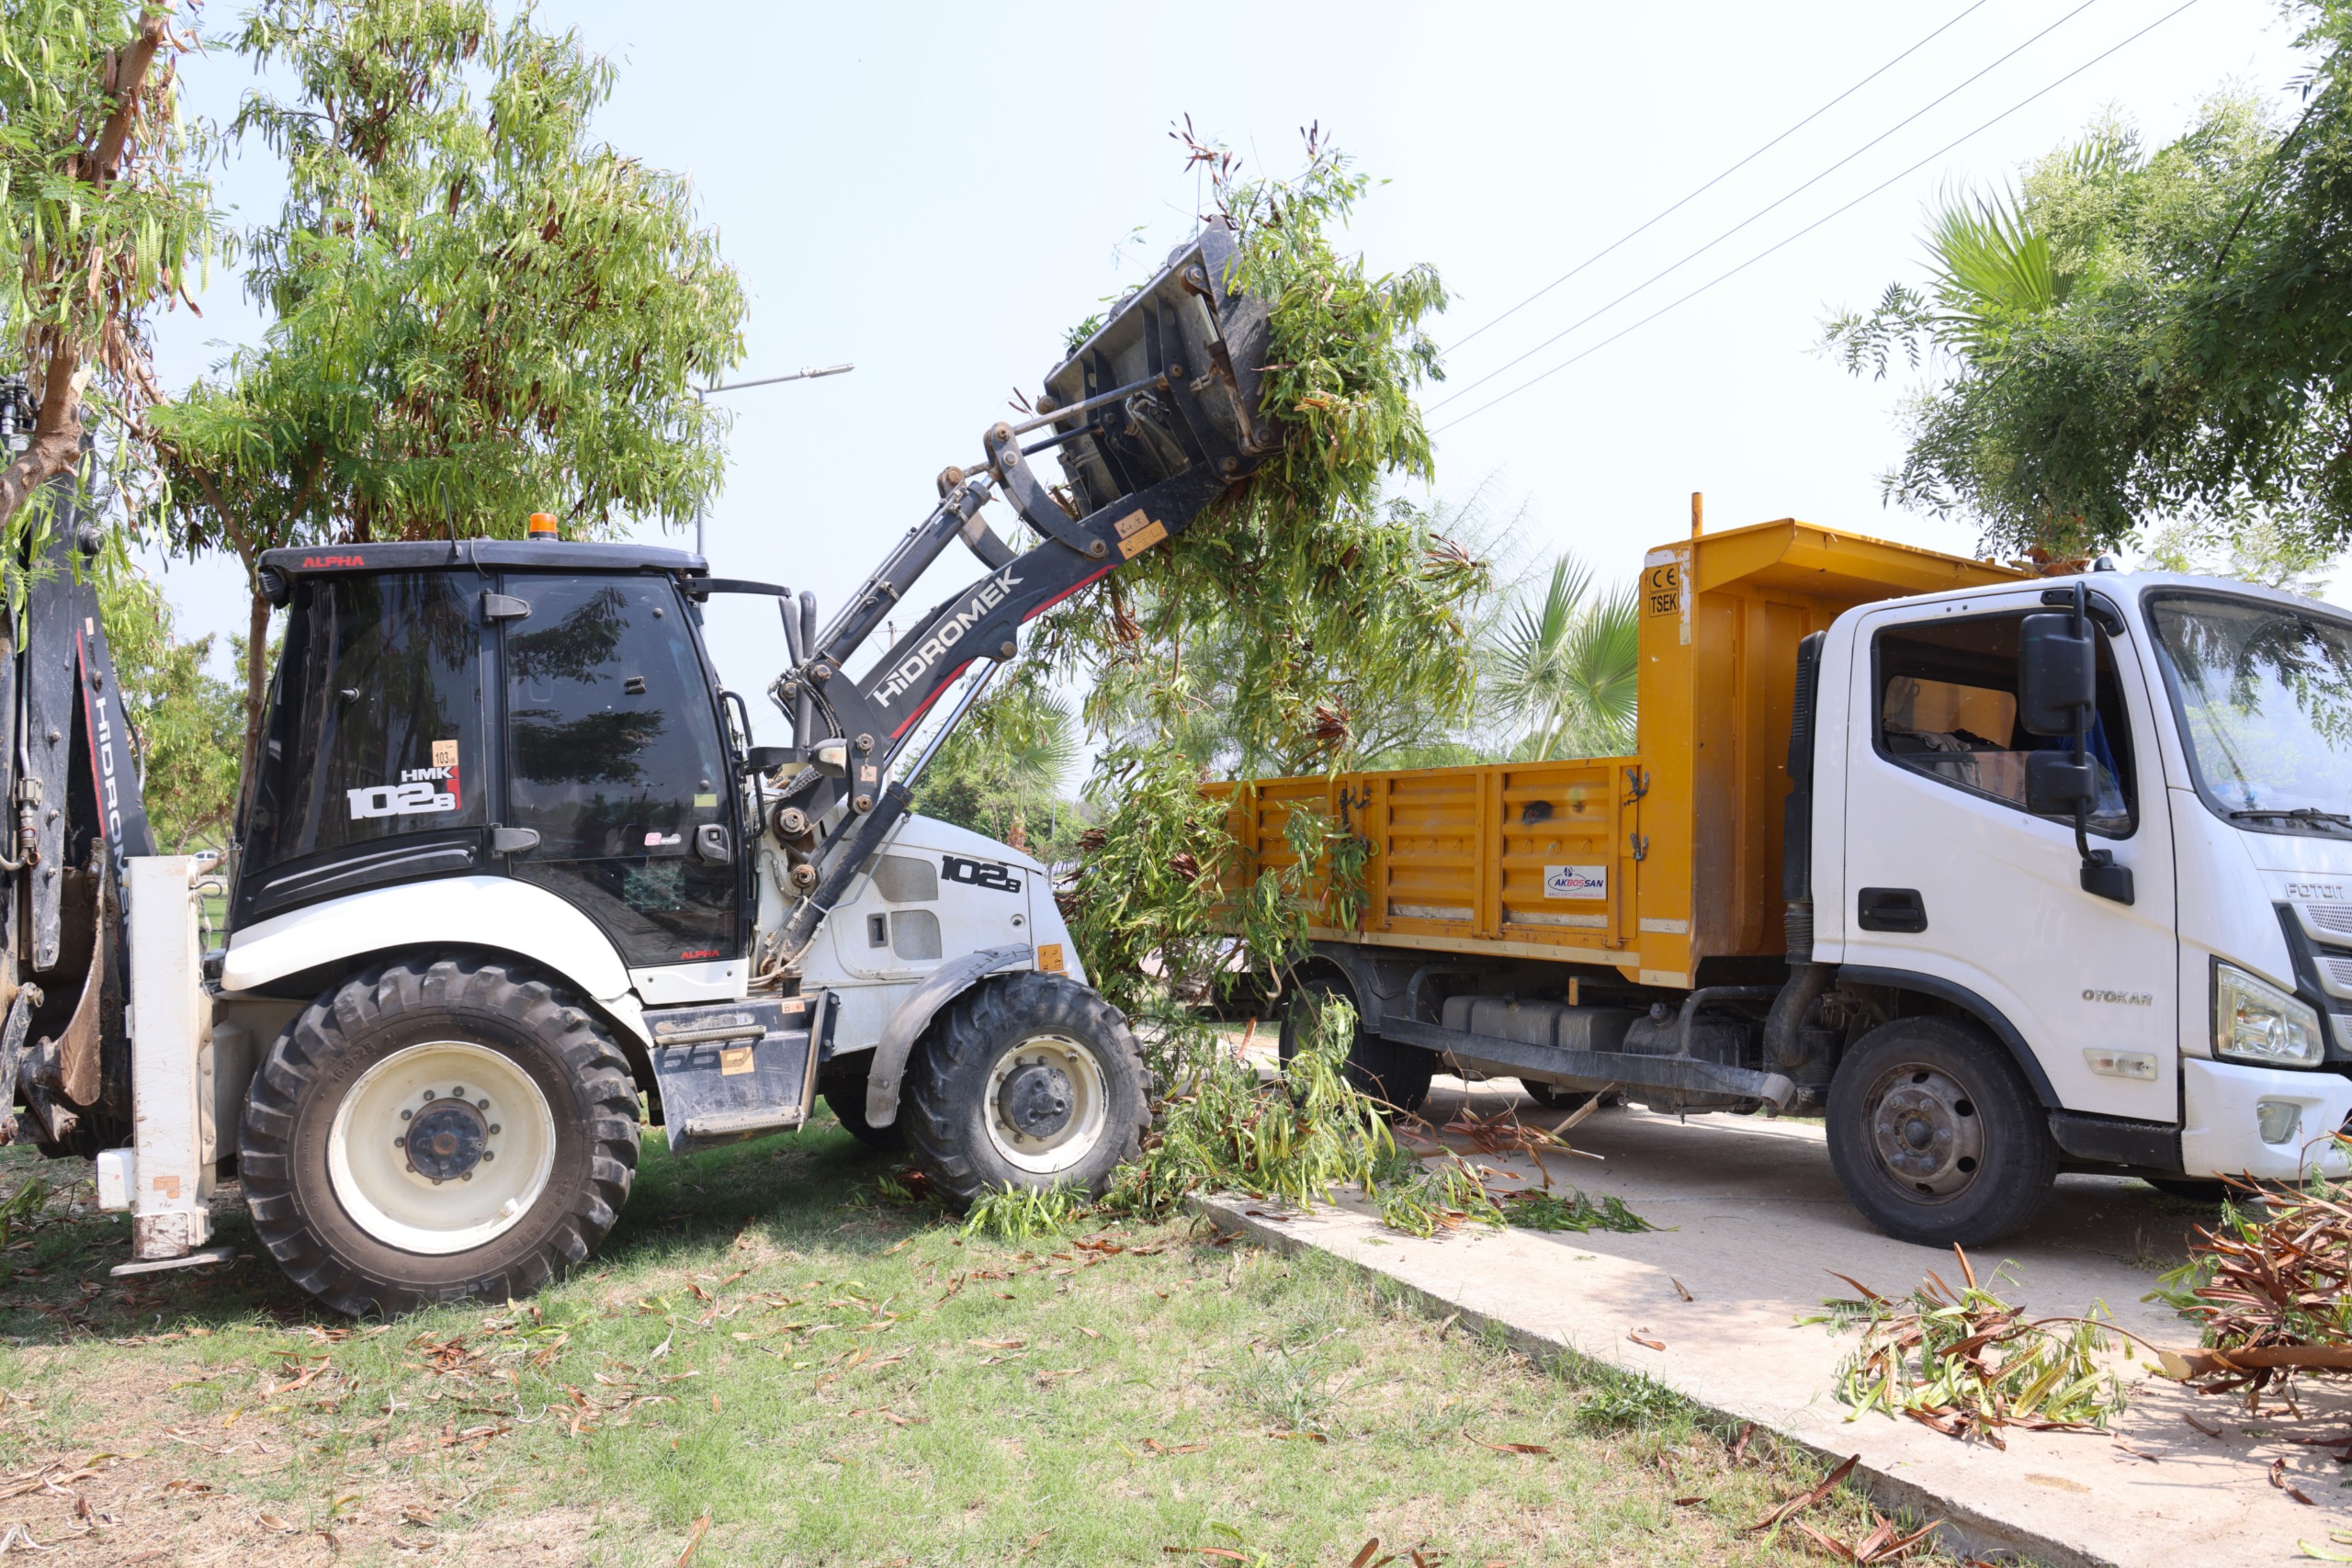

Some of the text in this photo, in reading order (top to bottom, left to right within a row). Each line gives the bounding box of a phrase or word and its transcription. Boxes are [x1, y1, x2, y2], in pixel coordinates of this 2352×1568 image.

[302, 556, 365, 569] ALPHA
[1652, 568, 1677, 588] CE
[1650, 593, 1677, 614] TSEK
[435, 751, 449, 765] 103
[401, 766, 454, 782] HMK
[346, 782, 457, 820] 102B
[941, 854, 1022, 894] 102B
[1555, 878, 1604, 888] AKBOSSAN
[2285, 884, 2345, 899] FOTON
[681, 949, 720, 960] ALPHA
[2082, 988, 2154, 1007] OTOKAR
